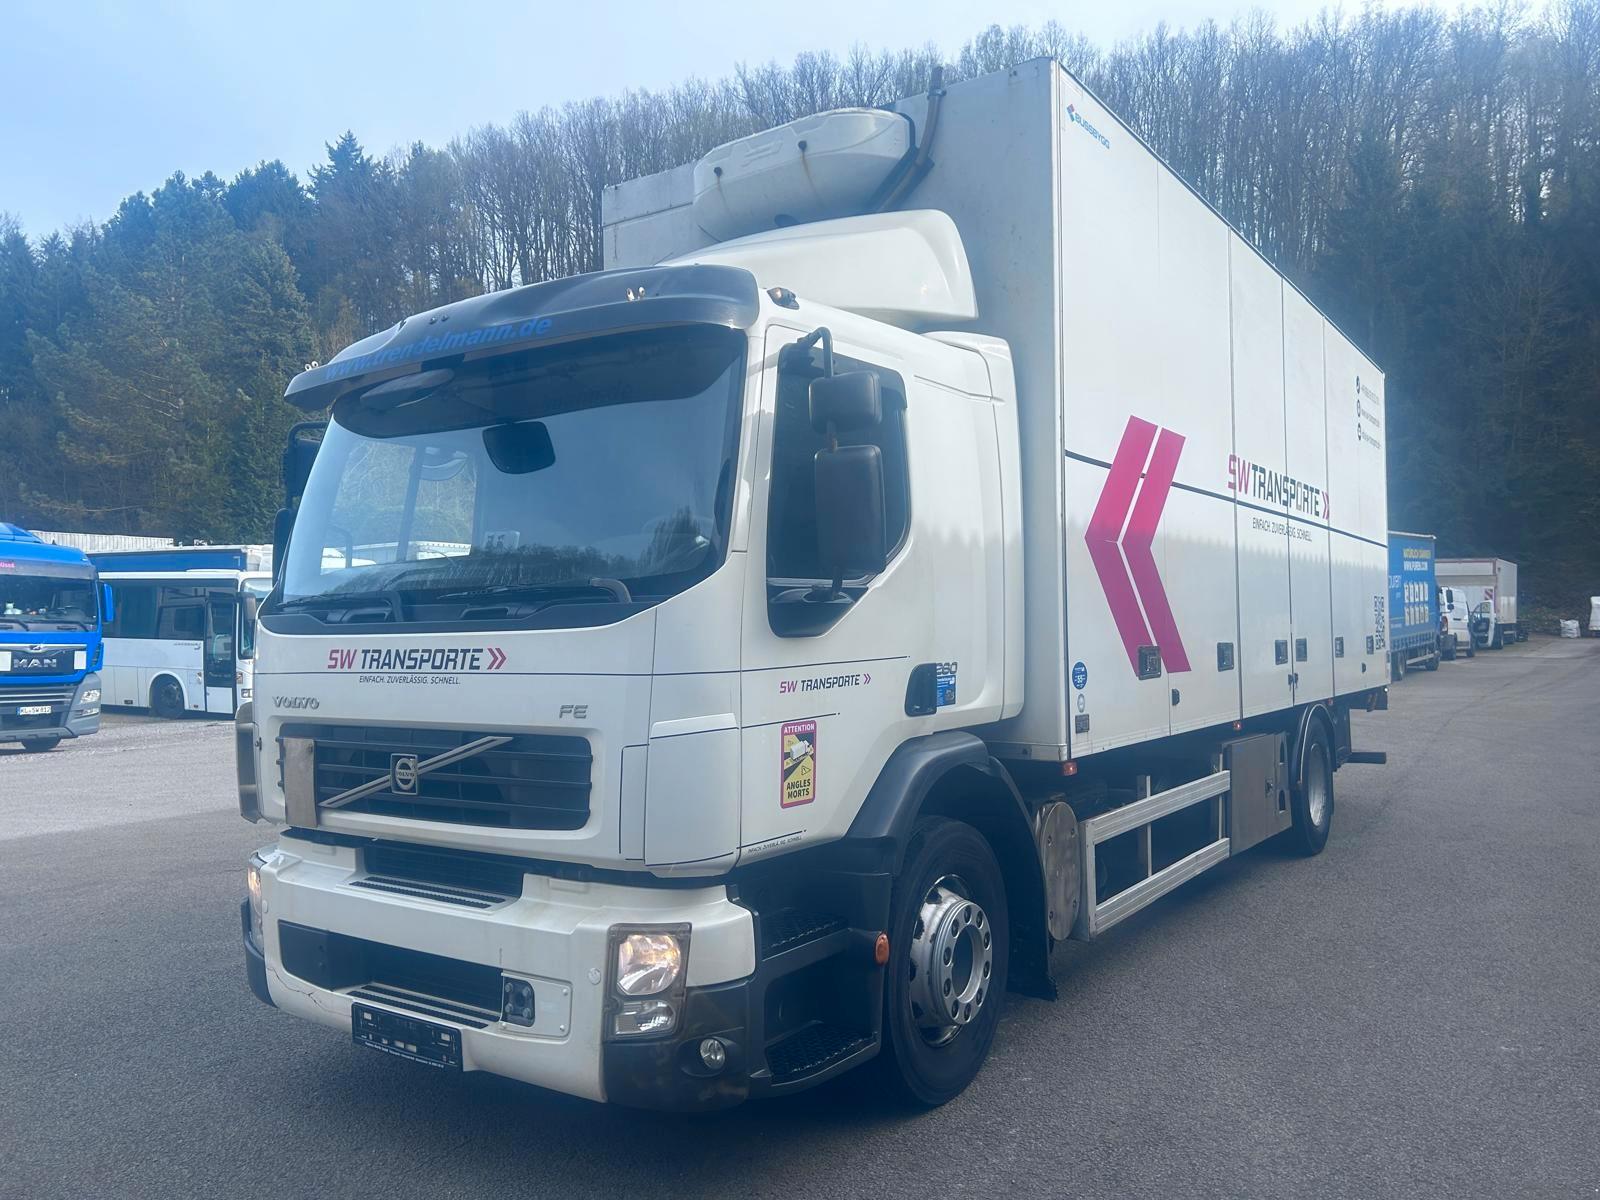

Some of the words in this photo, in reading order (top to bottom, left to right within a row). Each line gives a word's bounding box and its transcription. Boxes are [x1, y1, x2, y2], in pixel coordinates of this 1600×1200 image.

[325, 317, 553, 381] www.trendelmann.de
[13, 658, 57, 669] MAN
[327, 649, 358, 669] SW
[361, 648, 484, 670] TRANSPORTE
[359, 675, 385, 684] EINFACH.
[779, 680, 798, 694] SW
[800, 674, 860, 692] TRANSPORTE
[271, 695, 320, 710] VOLVO
[559, 704, 588, 719] FE
[783, 723, 815, 734] ATTENTION
[786, 778, 811, 790] ANGLES
[787, 787, 810, 799] MORTS
